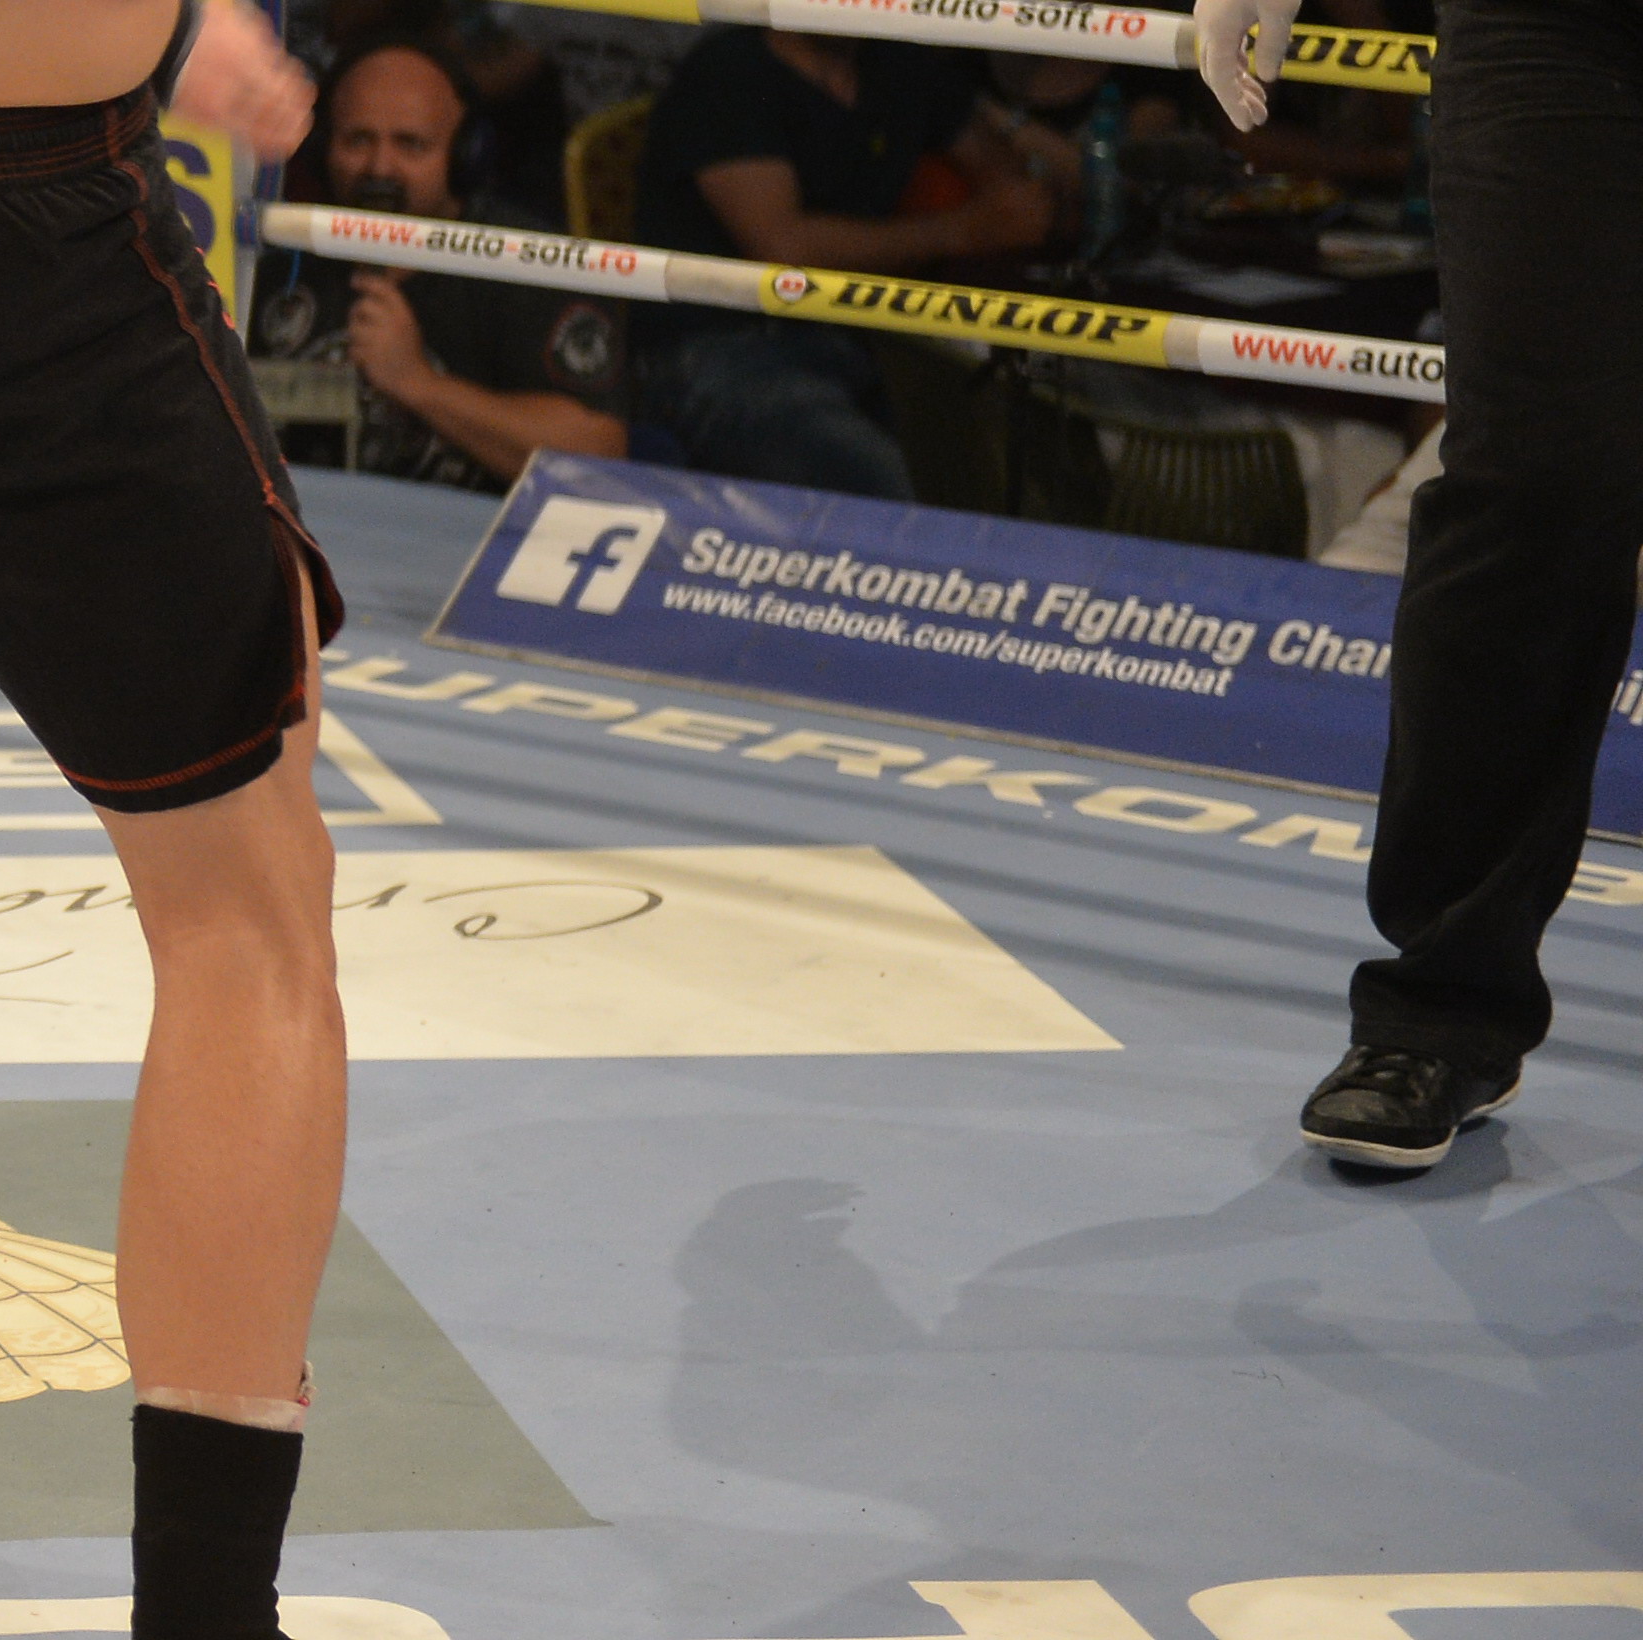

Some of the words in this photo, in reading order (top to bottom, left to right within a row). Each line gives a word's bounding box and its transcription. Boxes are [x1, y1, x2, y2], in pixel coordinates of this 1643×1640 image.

[330, 214, 637, 276] www.auto-soft.ro
[830, 284, 1152, 347] DUNLOP
[662, 580, 1233, 701] www.facebook.com/superkombat
[682, 527, 1030, 626] Superkombat
[1033, 582, 1259, 666] Fighting
